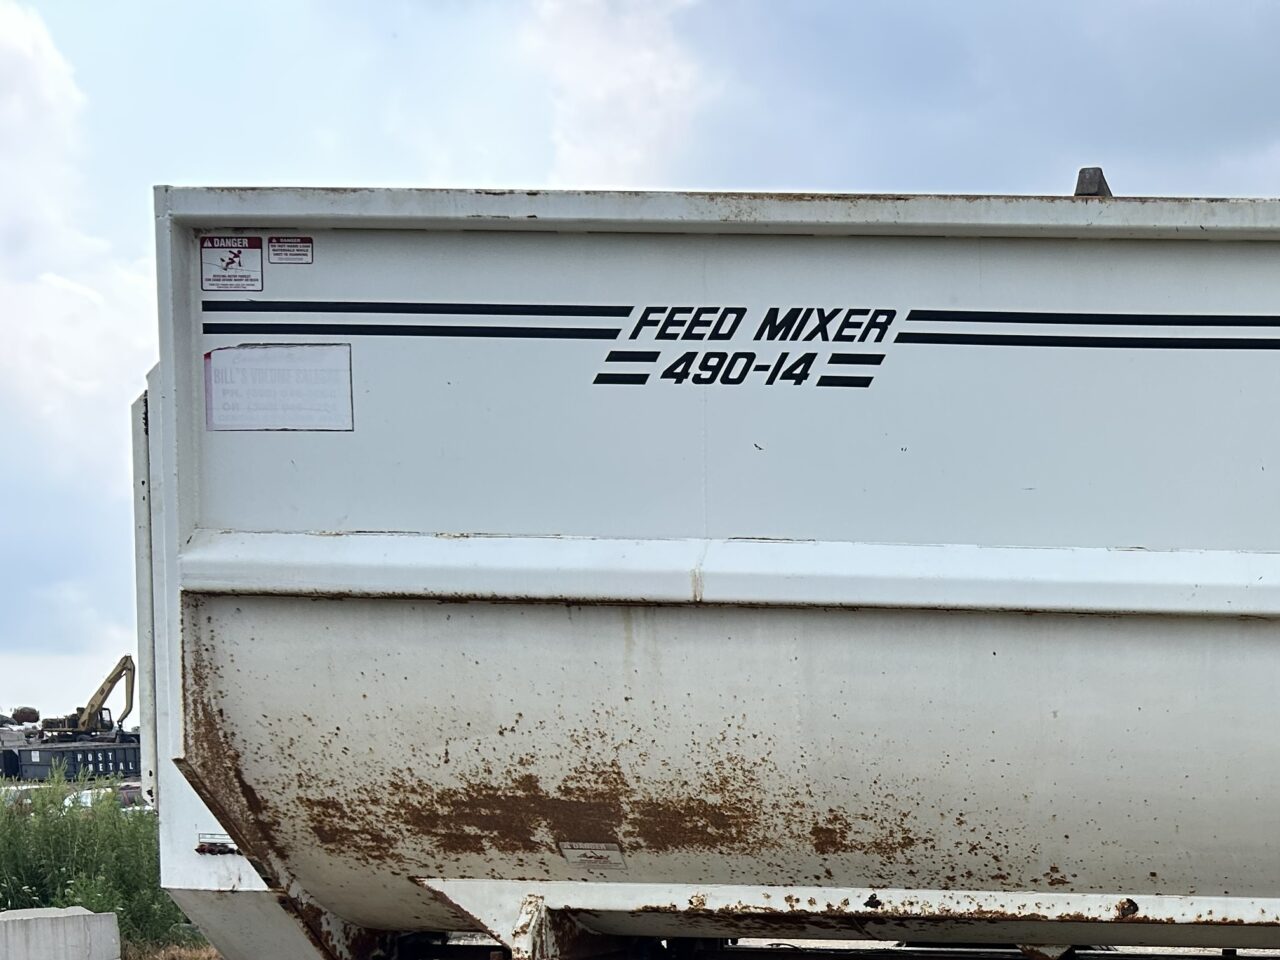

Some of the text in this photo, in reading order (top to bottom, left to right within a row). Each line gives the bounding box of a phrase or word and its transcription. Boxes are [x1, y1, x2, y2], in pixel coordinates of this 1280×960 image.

[214, 238, 248, 248] DANGER
[628, 306, 897, 343] FEED MIXER
[660, 351, 818, 386] 490-14
[77, 752, 113, 761] POST
[88, 762, 134, 771] METAL
